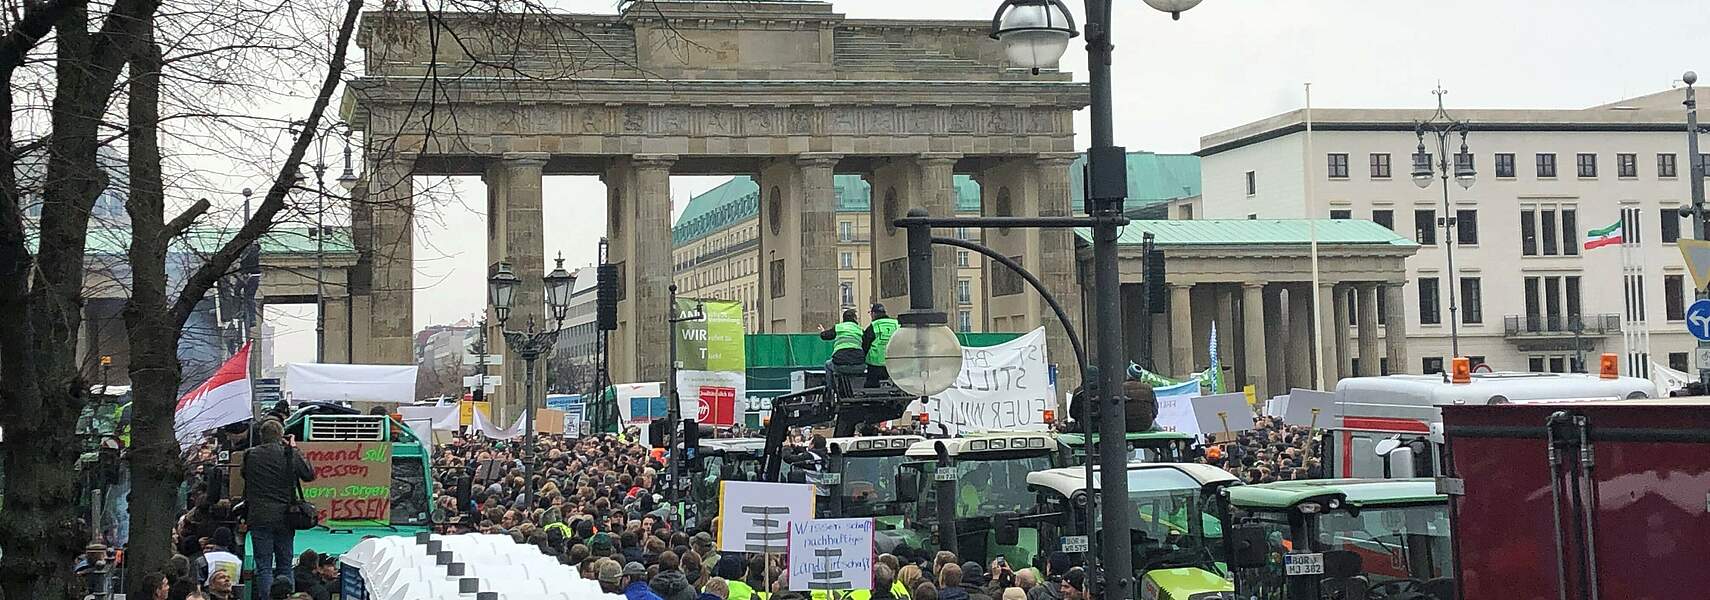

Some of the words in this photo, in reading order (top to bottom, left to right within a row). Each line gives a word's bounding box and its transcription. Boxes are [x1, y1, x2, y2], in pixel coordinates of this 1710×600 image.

[682, 329, 707, 340] WIR
[699, 347, 708, 359] T
[304, 443, 362, 461] mand
[314, 464, 369, 478] ressen
[331, 498, 389, 520] ESSEN
[1293, 556, 1310, 565] BOR
